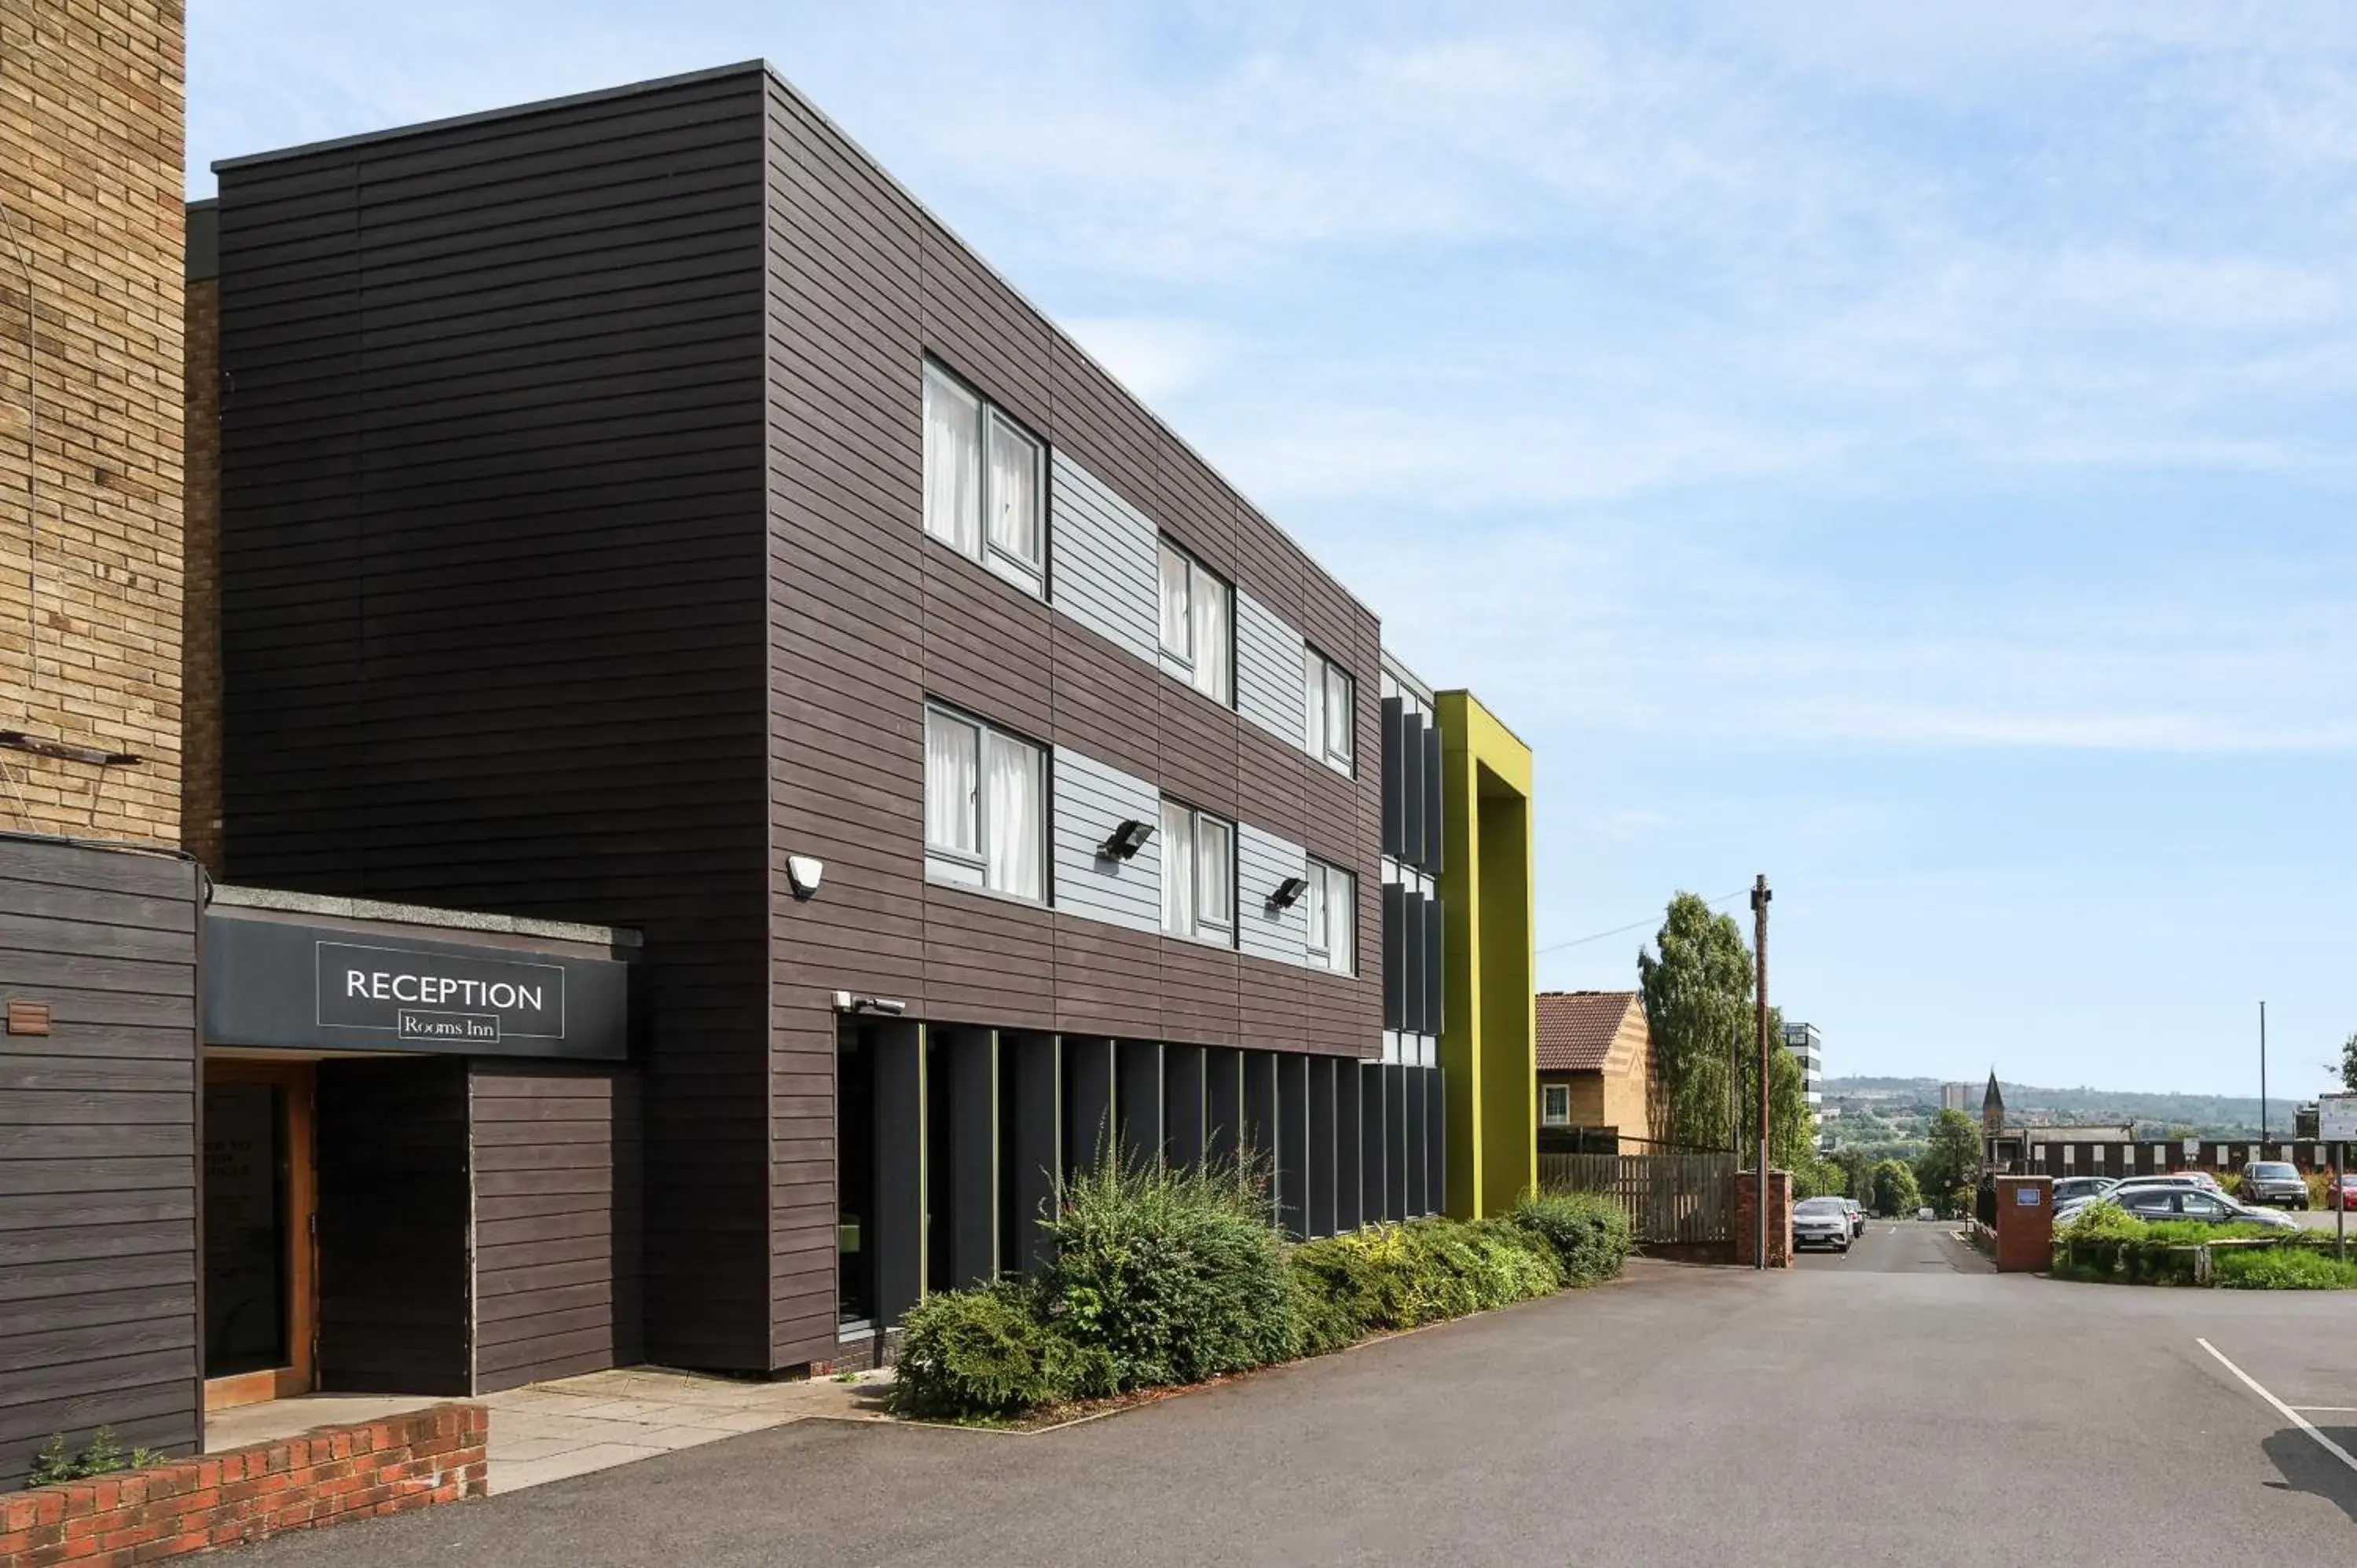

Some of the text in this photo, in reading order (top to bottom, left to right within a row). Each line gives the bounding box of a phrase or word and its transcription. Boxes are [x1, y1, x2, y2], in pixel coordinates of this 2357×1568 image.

[346, 969, 541, 1011] RECEPTION
[405, 1016, 494, 1036] Rooms Inn
